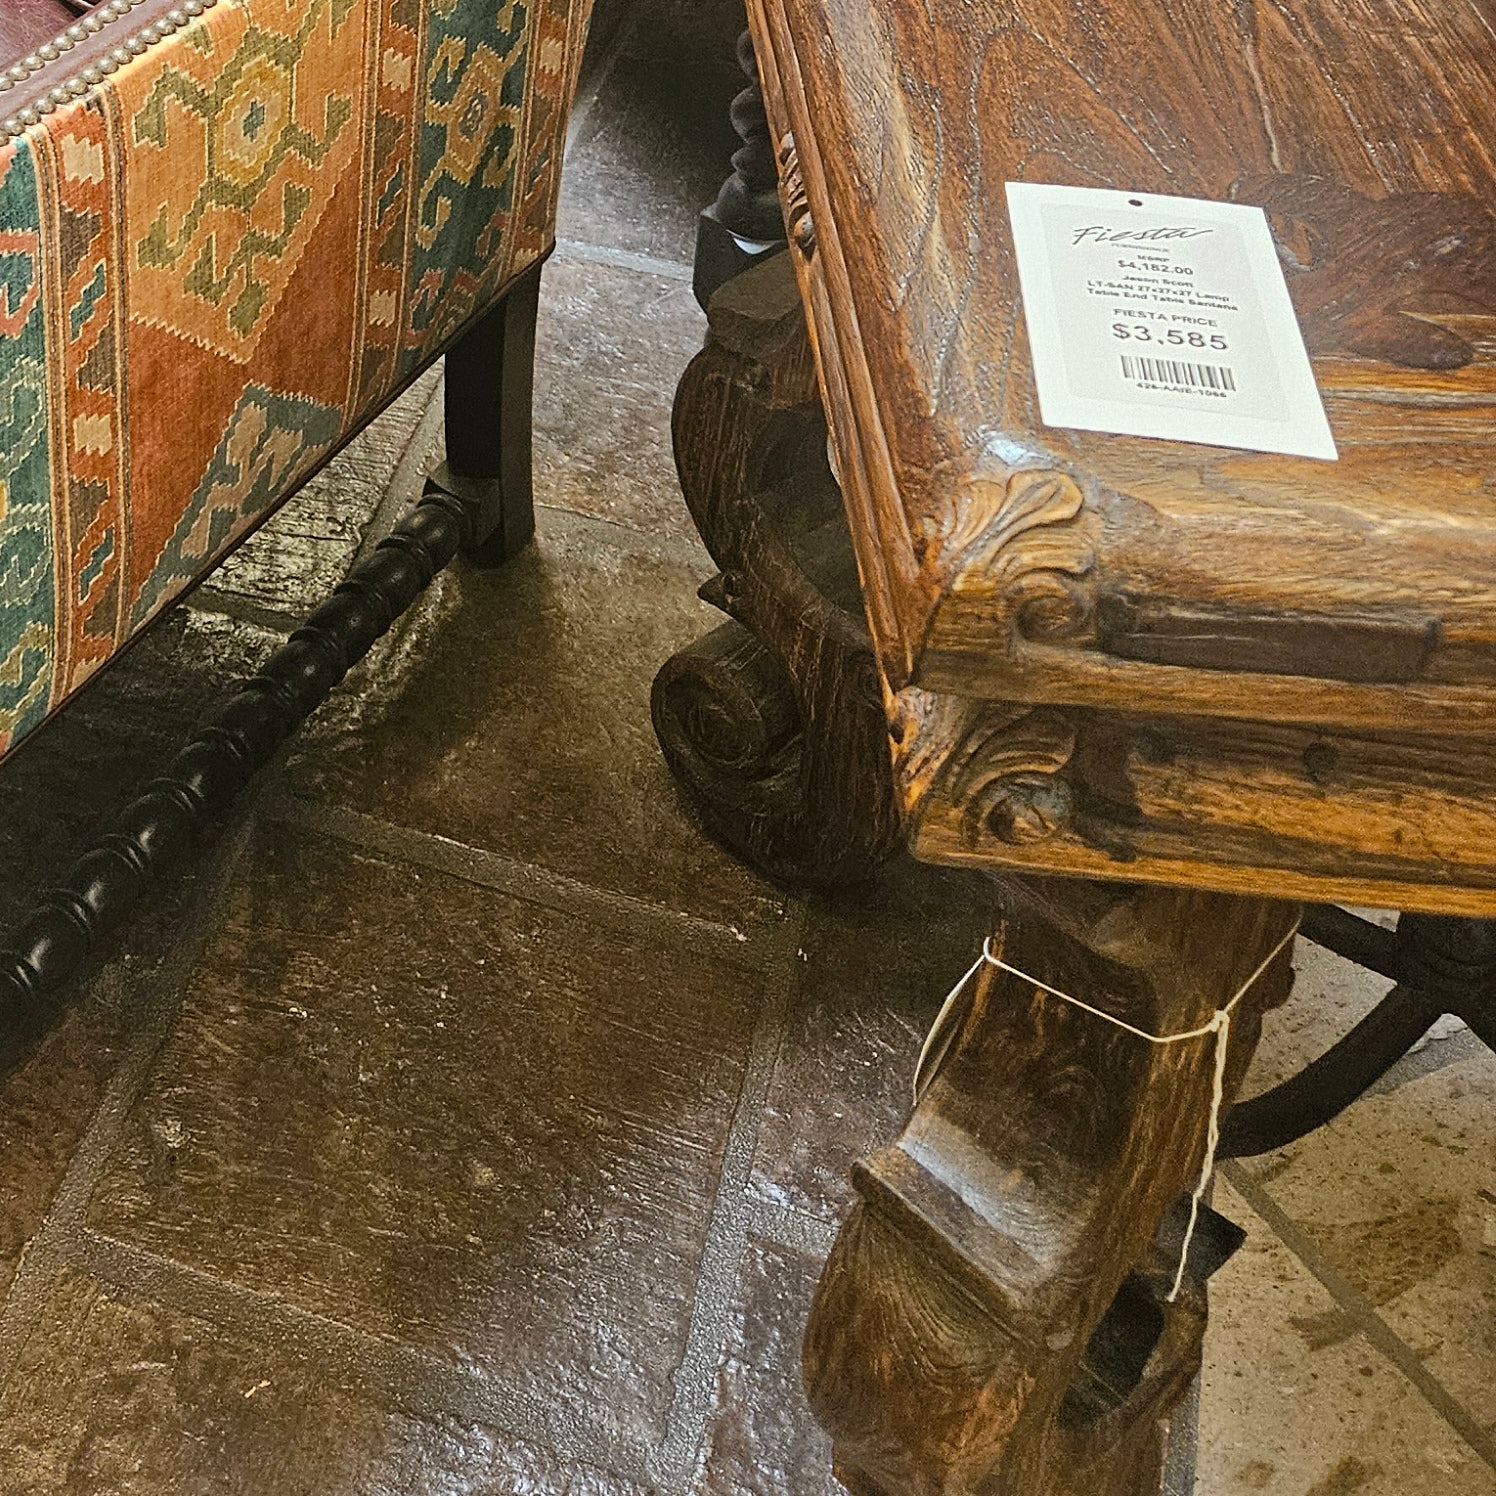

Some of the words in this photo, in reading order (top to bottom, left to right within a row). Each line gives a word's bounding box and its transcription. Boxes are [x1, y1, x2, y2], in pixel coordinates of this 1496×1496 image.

[1072, 226, 1214, 245] Fiesta
[1118, 259, 1194, 275] $4,182.00
[1124, 291, 1148, 300] End
[1113, 308, 1168, 322] FIESTA
[1171, 314, 1218, 328] PRICE
[1112, 322, 1229, 350] $3,585
